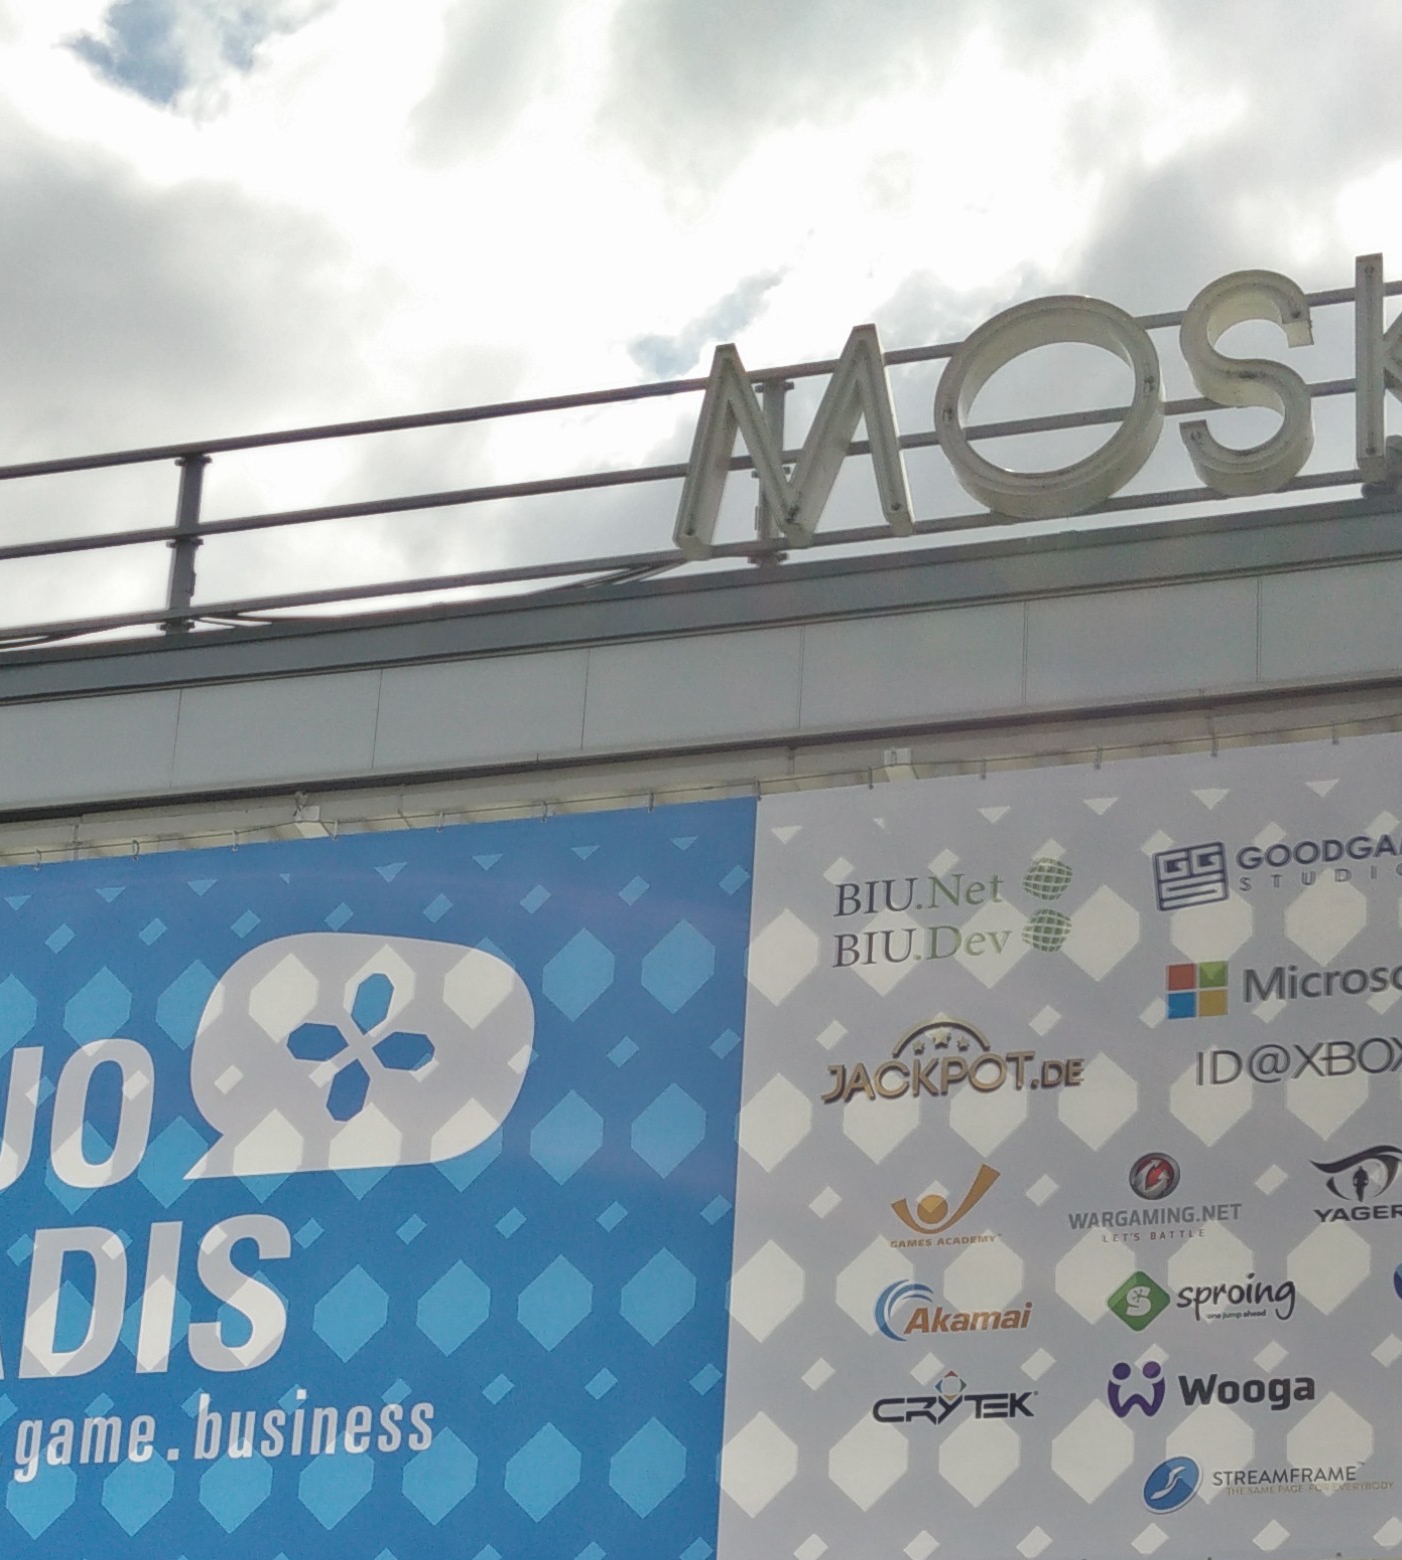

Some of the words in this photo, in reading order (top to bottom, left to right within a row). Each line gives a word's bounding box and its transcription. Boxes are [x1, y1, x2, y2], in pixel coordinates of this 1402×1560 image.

[833, 873, 1005, 917] BIU.Net
[832, 925, 1013, 968] BIU.Dev
[821, 1050, 1085, 1104] JACKPOT.DE
[1068, 1203, 1243, 1230] WARGAMING.NET
[890, 1237, 933, 1248] GAMES
[936, 1234, 997, 1247] ACADEMY
[1150, 1228, 1206, 1241] BATTLE
[1176, 1273, 1296, 1321] sproing
[1243, 1309, 1266, 1319] ahead
[903, 1301, 1033, 1335] Akamai
[872, 1391, 1035, 1425] CRYTEK
[1177, 1374, 1316, 1411] Wooga
[193, 1389, 436, 1459] business
[1212, 1465, 1357, 1487] STREAMFRAME
[1226, 1486, 1246, 1496] THE
[1248, 1485, 1276, 1495] SAME
[1278, 1484, 1304, 1494] PAGE
